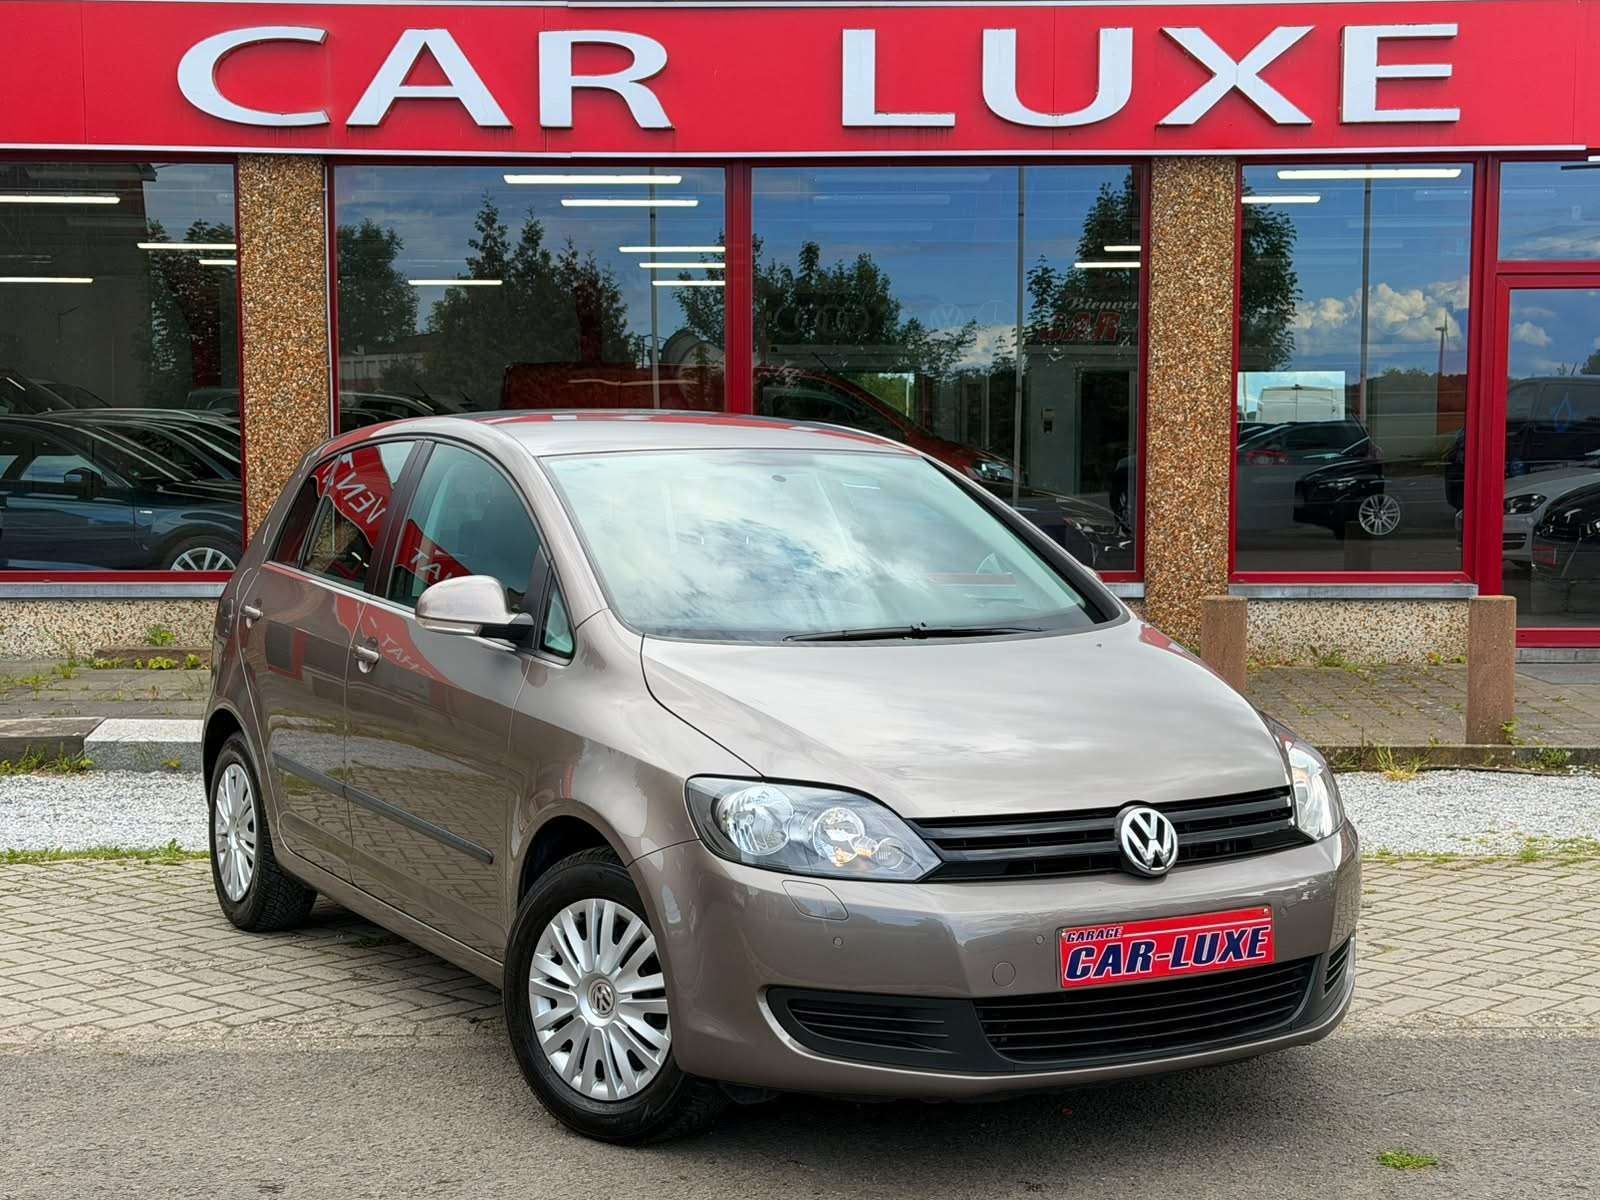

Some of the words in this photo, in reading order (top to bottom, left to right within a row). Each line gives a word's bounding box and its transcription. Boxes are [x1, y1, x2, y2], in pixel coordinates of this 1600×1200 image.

[177, 26, 675, 129] CAR
[841, 23, 1461, 129] LUXE
[1065, 925, 1271, 981] CAR-LUXE
[1066, 926, 1123, 943] GARAGE
